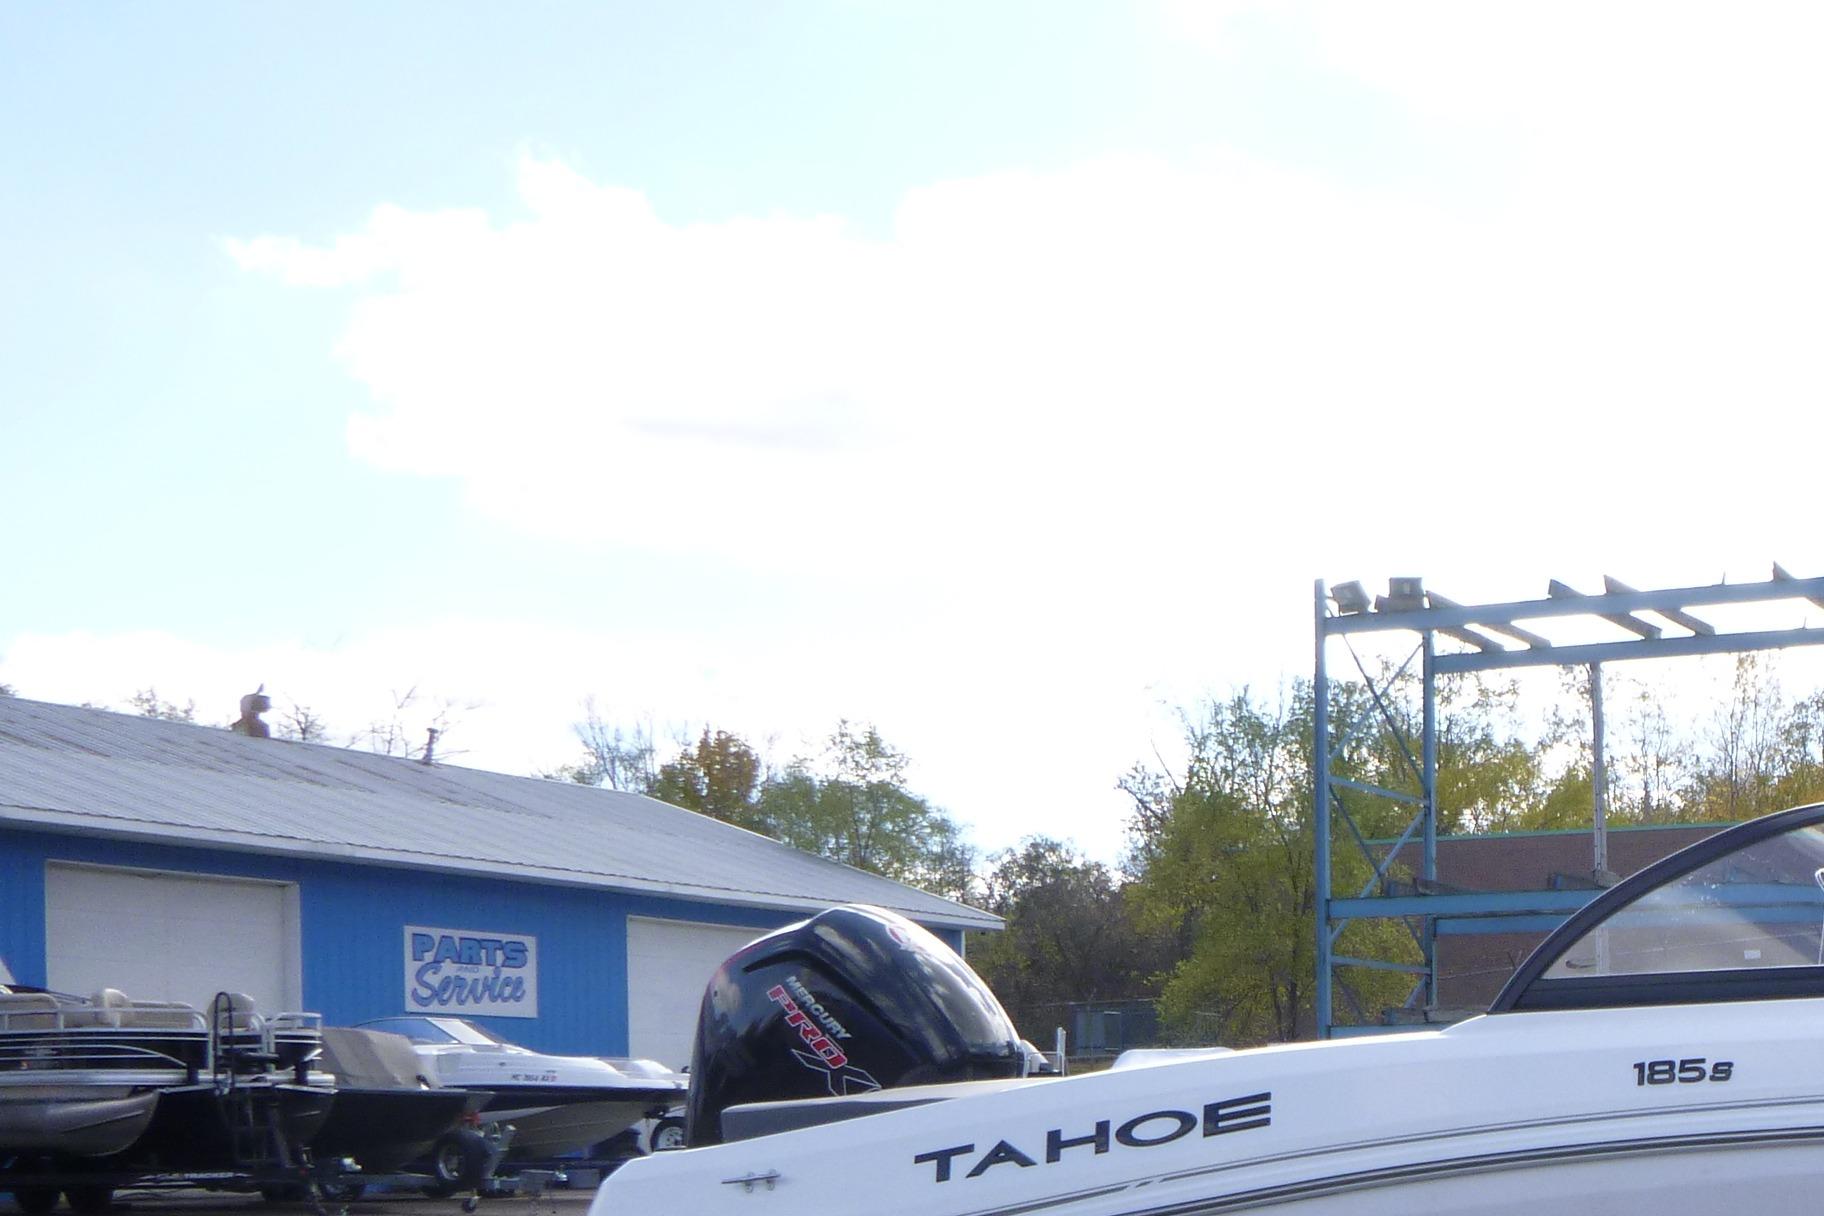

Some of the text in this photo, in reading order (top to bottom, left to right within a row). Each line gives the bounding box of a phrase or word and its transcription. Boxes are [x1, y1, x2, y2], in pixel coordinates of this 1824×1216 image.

[411, 932, 529, 969] PARTS
[411, 960, 526, 1007] Service
[786, 976, 852, 1039] MERCURY
[766, 984, 848, 1069] PRO
[913, 1091, 1272, 1183] TAHOE
